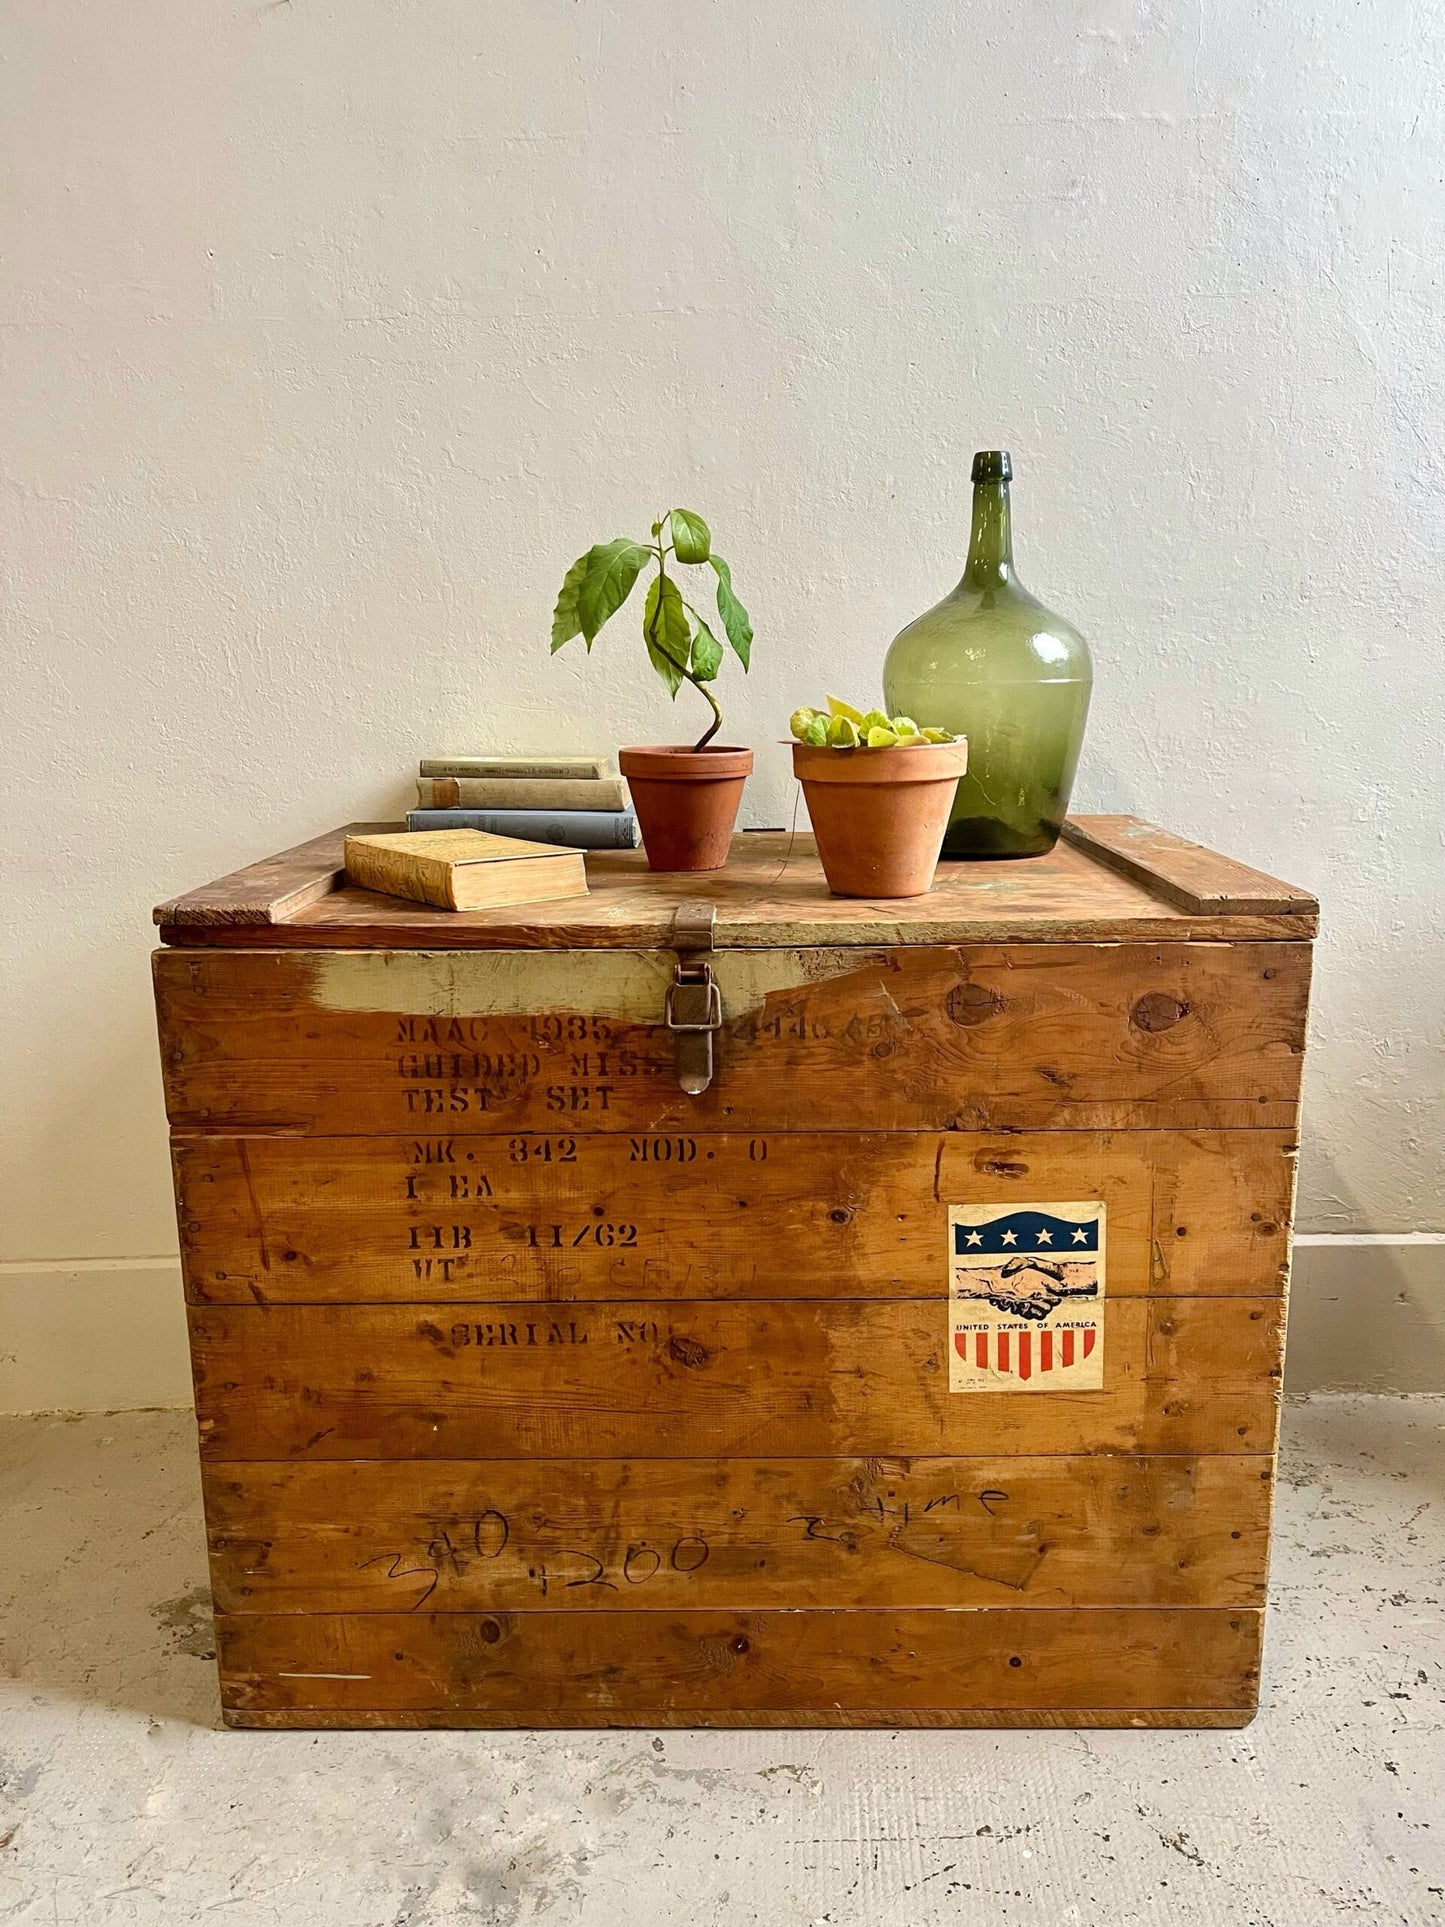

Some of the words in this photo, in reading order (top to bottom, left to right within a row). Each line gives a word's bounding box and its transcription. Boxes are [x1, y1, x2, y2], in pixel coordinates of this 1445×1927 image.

[397, 1051, 541, 1079] GUIDED
[402, 1087, 490, 1113] TEST
[546, 1085, 615, 1112] SET
[413, 1139, 475, 1164] MK.
[508, 1137, 578, 1163] 342
[629, 1137, 716, 1163] MOD.
[449, 1174, 494, 1199] EA
[451, 1321, 588, 1347] SERIAL
[956, 1323, 990, 1331] UNITED
[1055, 1321, 1097, 1329] AMERICA
